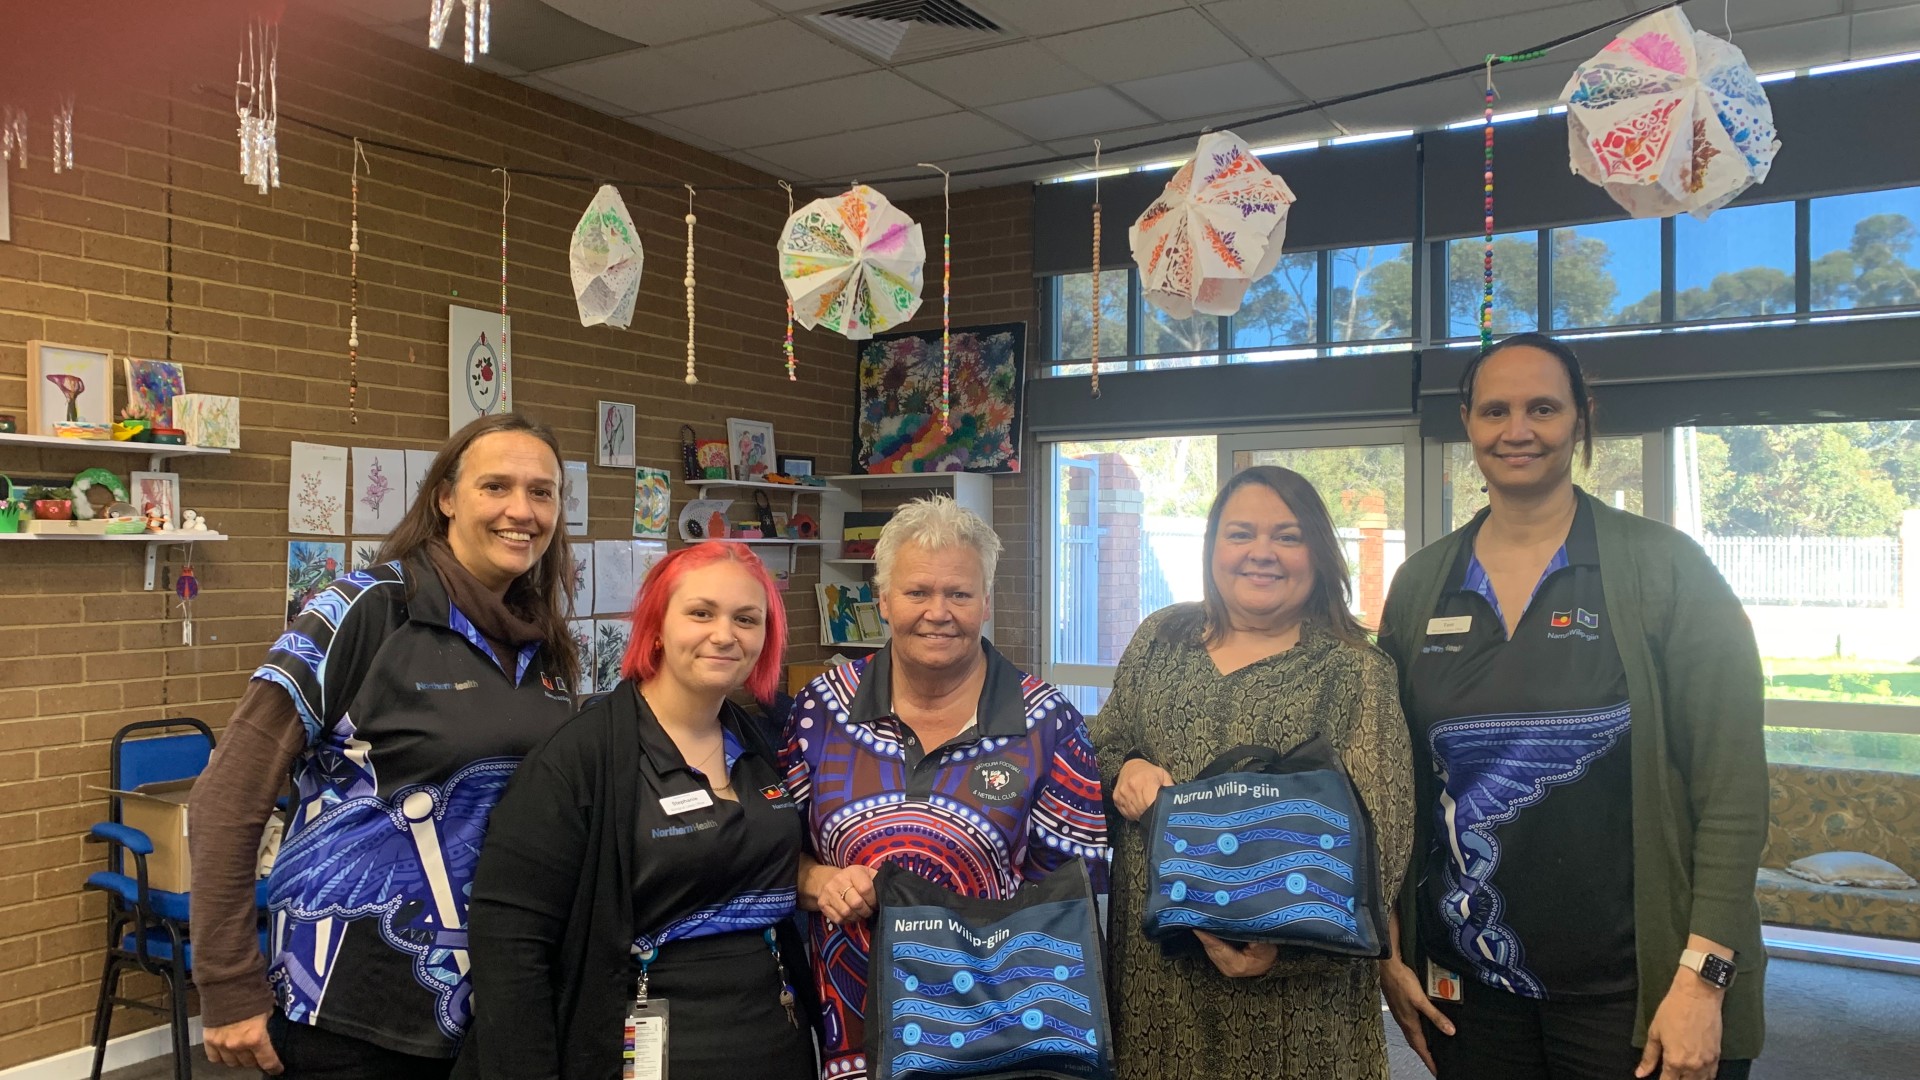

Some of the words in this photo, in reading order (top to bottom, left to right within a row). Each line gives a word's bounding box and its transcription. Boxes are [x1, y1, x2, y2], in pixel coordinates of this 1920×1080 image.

[999, 761, 1020, 773] FOOTBALL
[978, 791, 1001, 800] NETBALL
[1002, 791, 1017, 800] CLUB
[1173, 790, 1213, 805] Narrun
[1214, 781, 1280, 799] Wilip-giin
[894, 919, 943, 932] Narrun
[948, 919, 1010, 949] Wilip-giin
